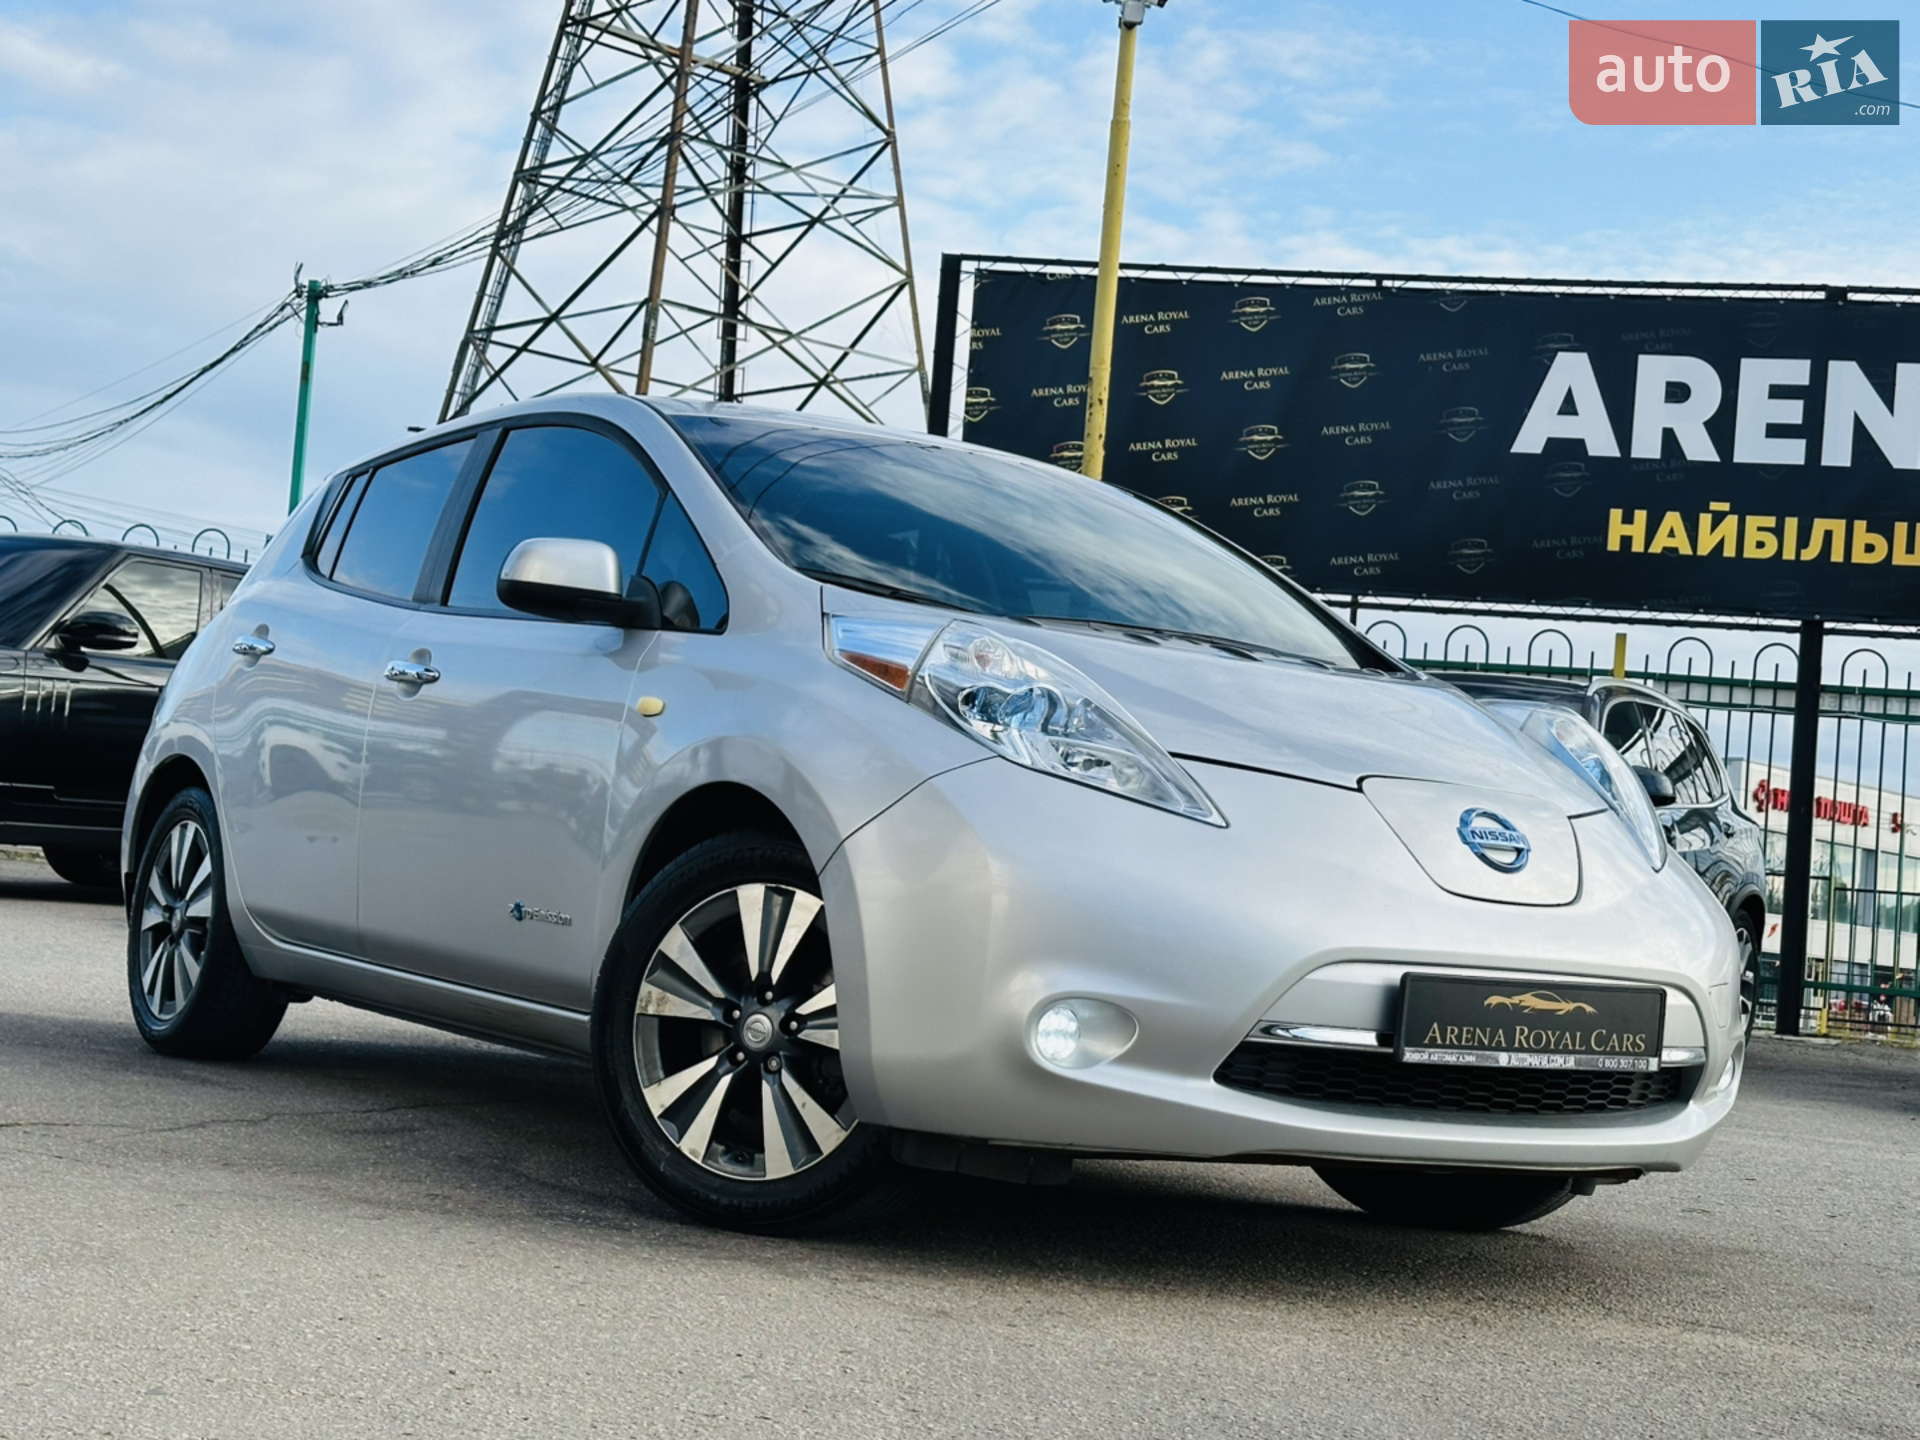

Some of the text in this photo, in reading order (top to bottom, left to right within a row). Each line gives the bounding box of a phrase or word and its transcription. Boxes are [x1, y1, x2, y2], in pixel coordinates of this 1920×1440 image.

[1313, 291, 1383, 306] ARENA ROYAL
[1121, 310, 1189, 324] ARENA ROYAL
[1336, 306, 1364, 317] CARS
[1144, 324, 1171, 334] CARS
[1220, 366, 1290, 380] ARENA ROYAL
[1031, 384, 1090, 397] ARENA ROY
[1243, 380, 1271, 391] CARS
[1053, 397, 1080, 407] CARS
[1321, 421, 1390, 435] ARENA ROYAL
[1128, 438, 1198, 451] ARENA ROYAL
[1344, 436, 1372, 446] CARS
[1151, 451, 1178, 462] CARS
[1428, 476, 1500, 489] ARENA ROYAL
[1230, 493, 1299, 506] ARENA ROYAL
[1452, 490, 1480, 501] CARS
[1253, 507, 1281, 517] CARS
[1330, 552, 1399, 565] ARENA ROYAL
[1353, 566, 1381, 576] CARS
[1470, 830, 1527, 847] NISSAN
[1423, 1022, 1646, 1053] ARENA ROYAL CARS
